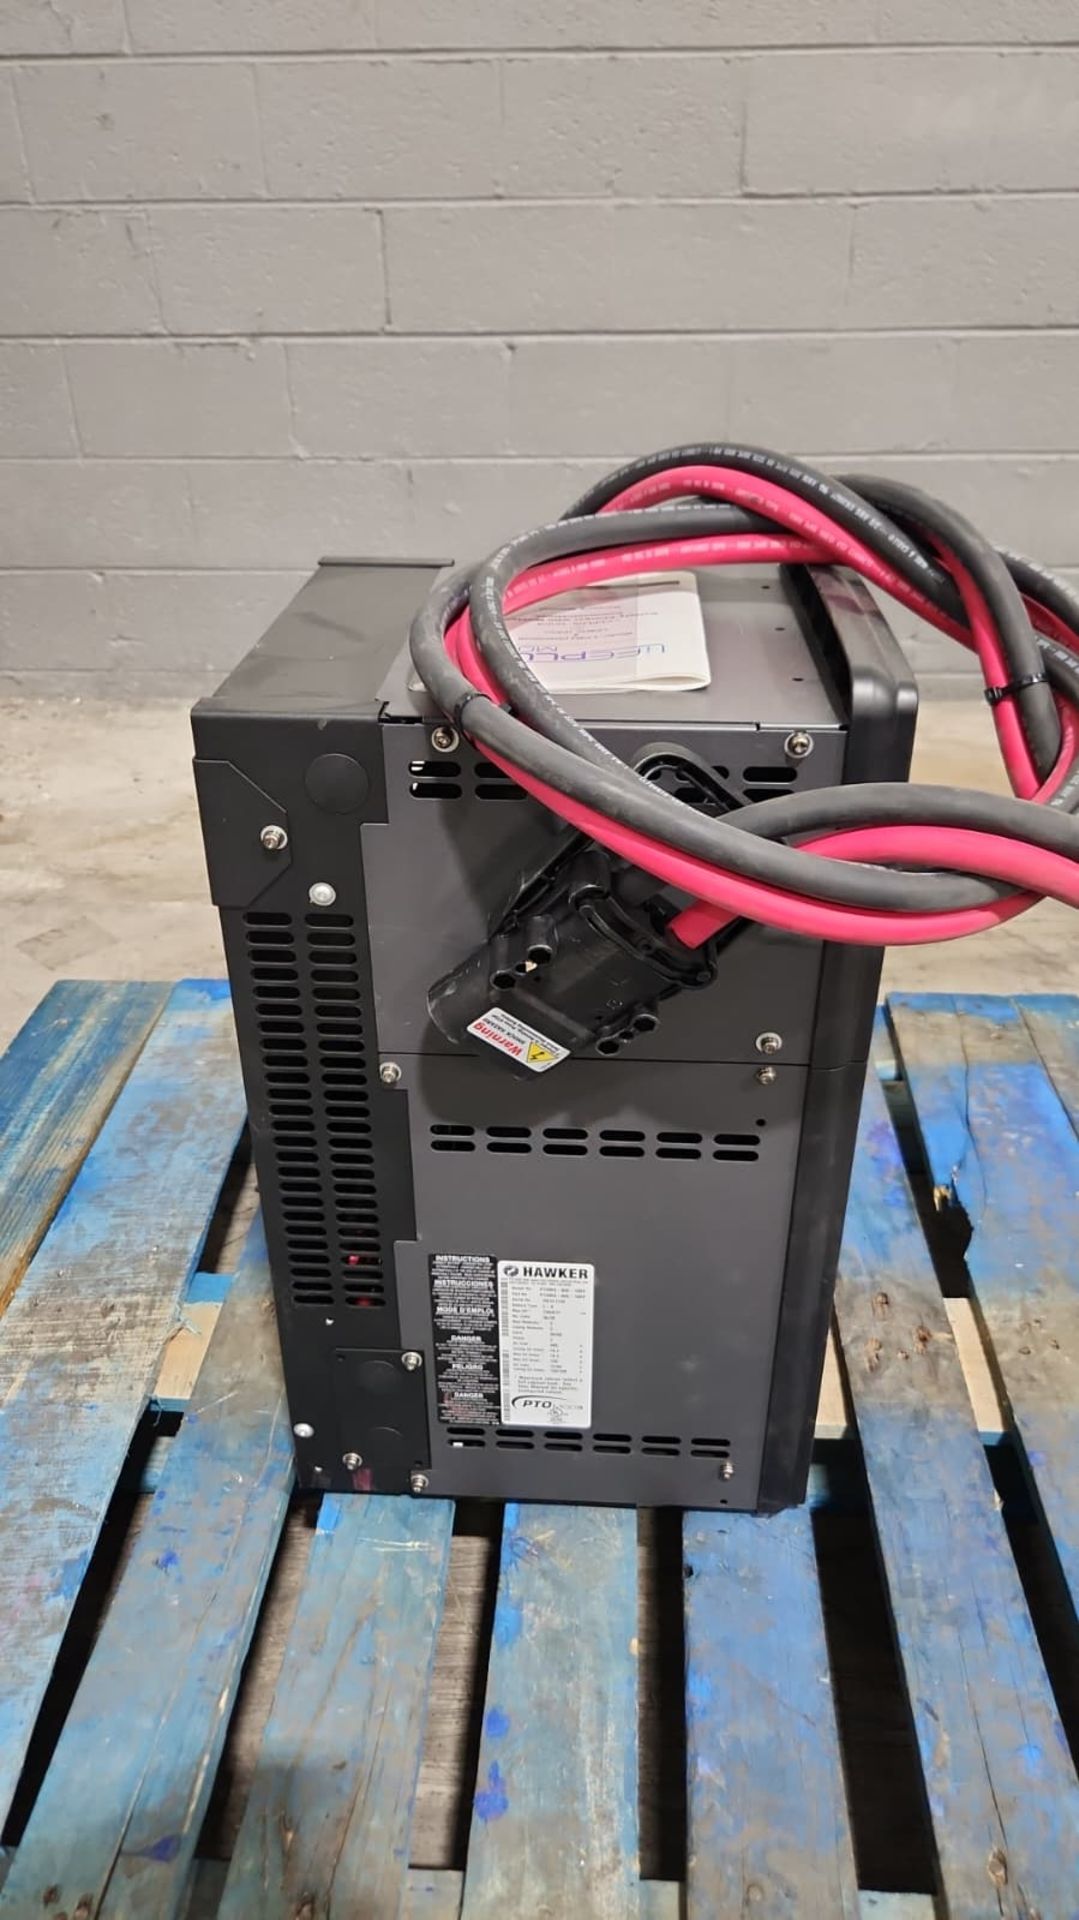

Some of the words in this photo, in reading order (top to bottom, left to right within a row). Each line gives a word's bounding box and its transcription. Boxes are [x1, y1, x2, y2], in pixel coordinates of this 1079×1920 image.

[473, 1022, 523, 1056] Warning
[435, 1255, 491, 1263] INSTRUCTIONS
[522, 1266, 589, 1279] HAWKER
[434, 1280, 494, 1288] INSTRUCCIONES
[436, 1306, 458, 1314] MODE
[522, 1399, 552, 1409] PTO
